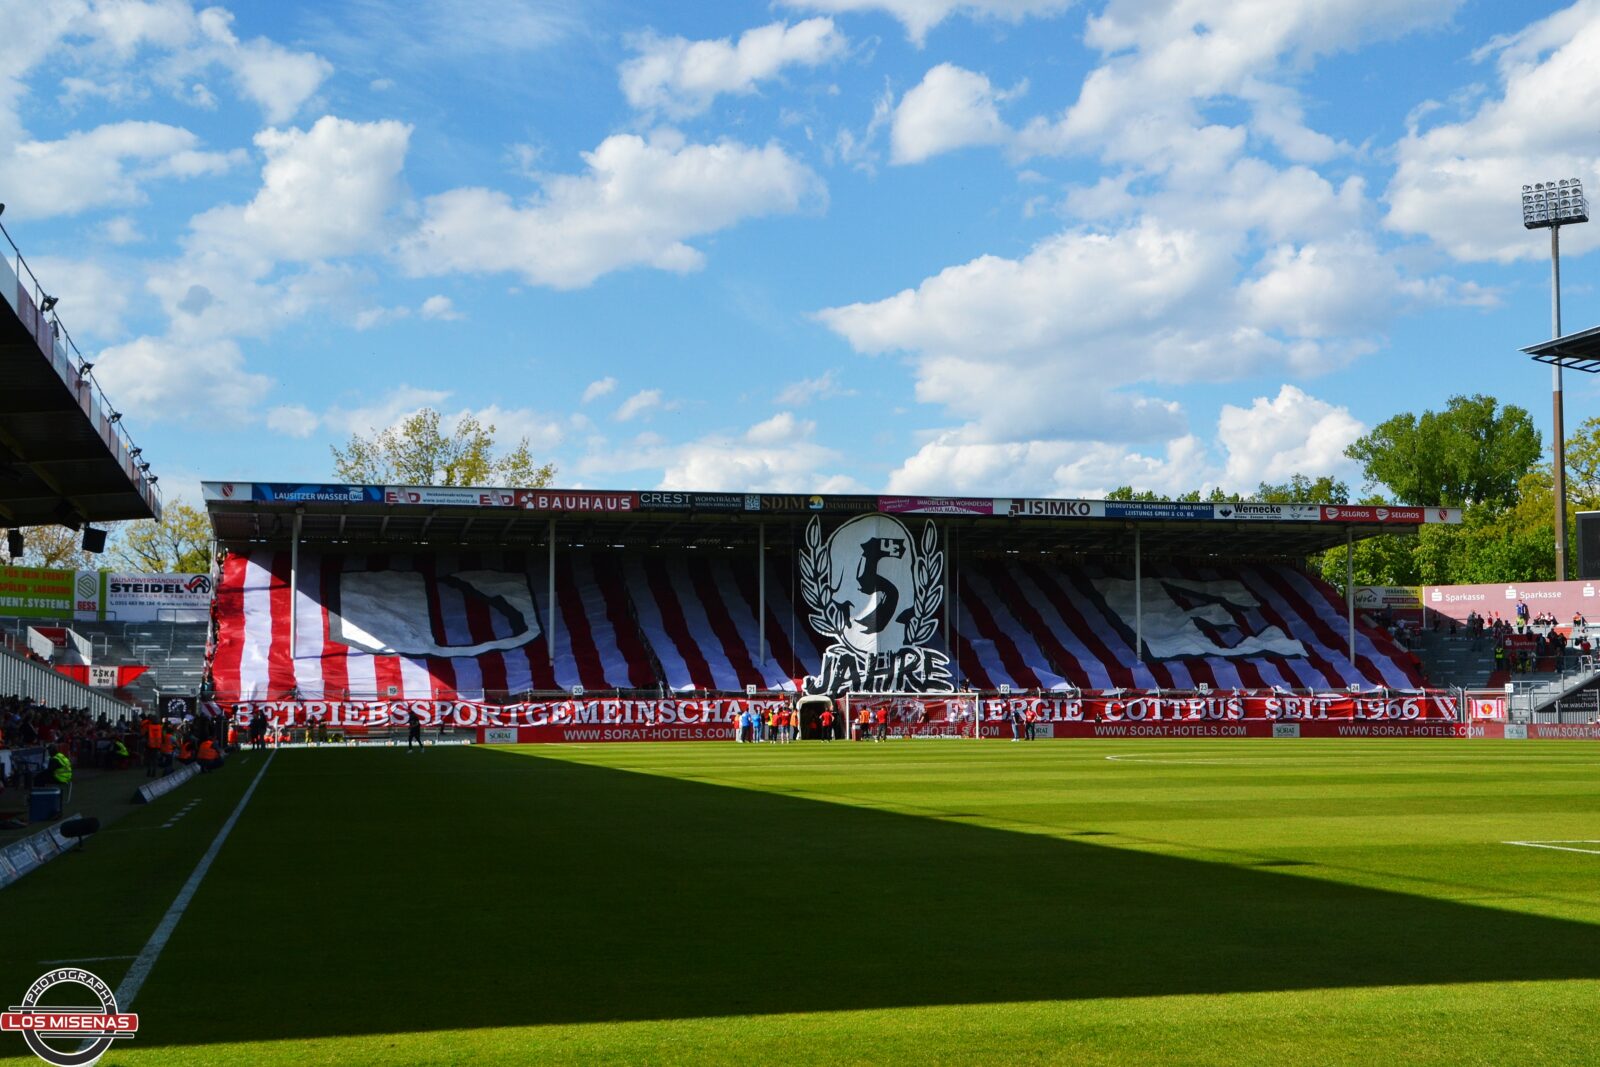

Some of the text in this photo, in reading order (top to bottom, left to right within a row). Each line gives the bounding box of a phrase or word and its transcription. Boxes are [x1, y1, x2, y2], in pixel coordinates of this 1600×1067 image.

[274, 491, 315, 500] LAUSITZER
[317, 492, 349, 501] WASSER
[640, 493, 691, 503] CREST
[538, 496, 630, 510] BAUHAUS
[761, 496, 806, 509] SDIM
[1029, 501, 1091, 516] ISIMKO
[1233, 504, 1282, 513] Wernecke
[110, 583, 184, 593] STEIDEL
[1445, 593, 1485, 603] Sparkasse
[1519, 590, 1562, 600] Sparkasse
[803, 646, 954, 696] JAHRE
[1104, 697, 1245, 721] COTTBUS
[1265, 697, 1332, 720] SEIT
[1354, 697, 1420, 720] 1966
[564, 727, 736, 741] WWW.SORAT-HOTELS.COM
[1094, 725, 1247, 737] WWW.SORAT-HOTELS.COM
[1338, 725, 1485, 737] WWW.SORAT-HOTELS.COM
